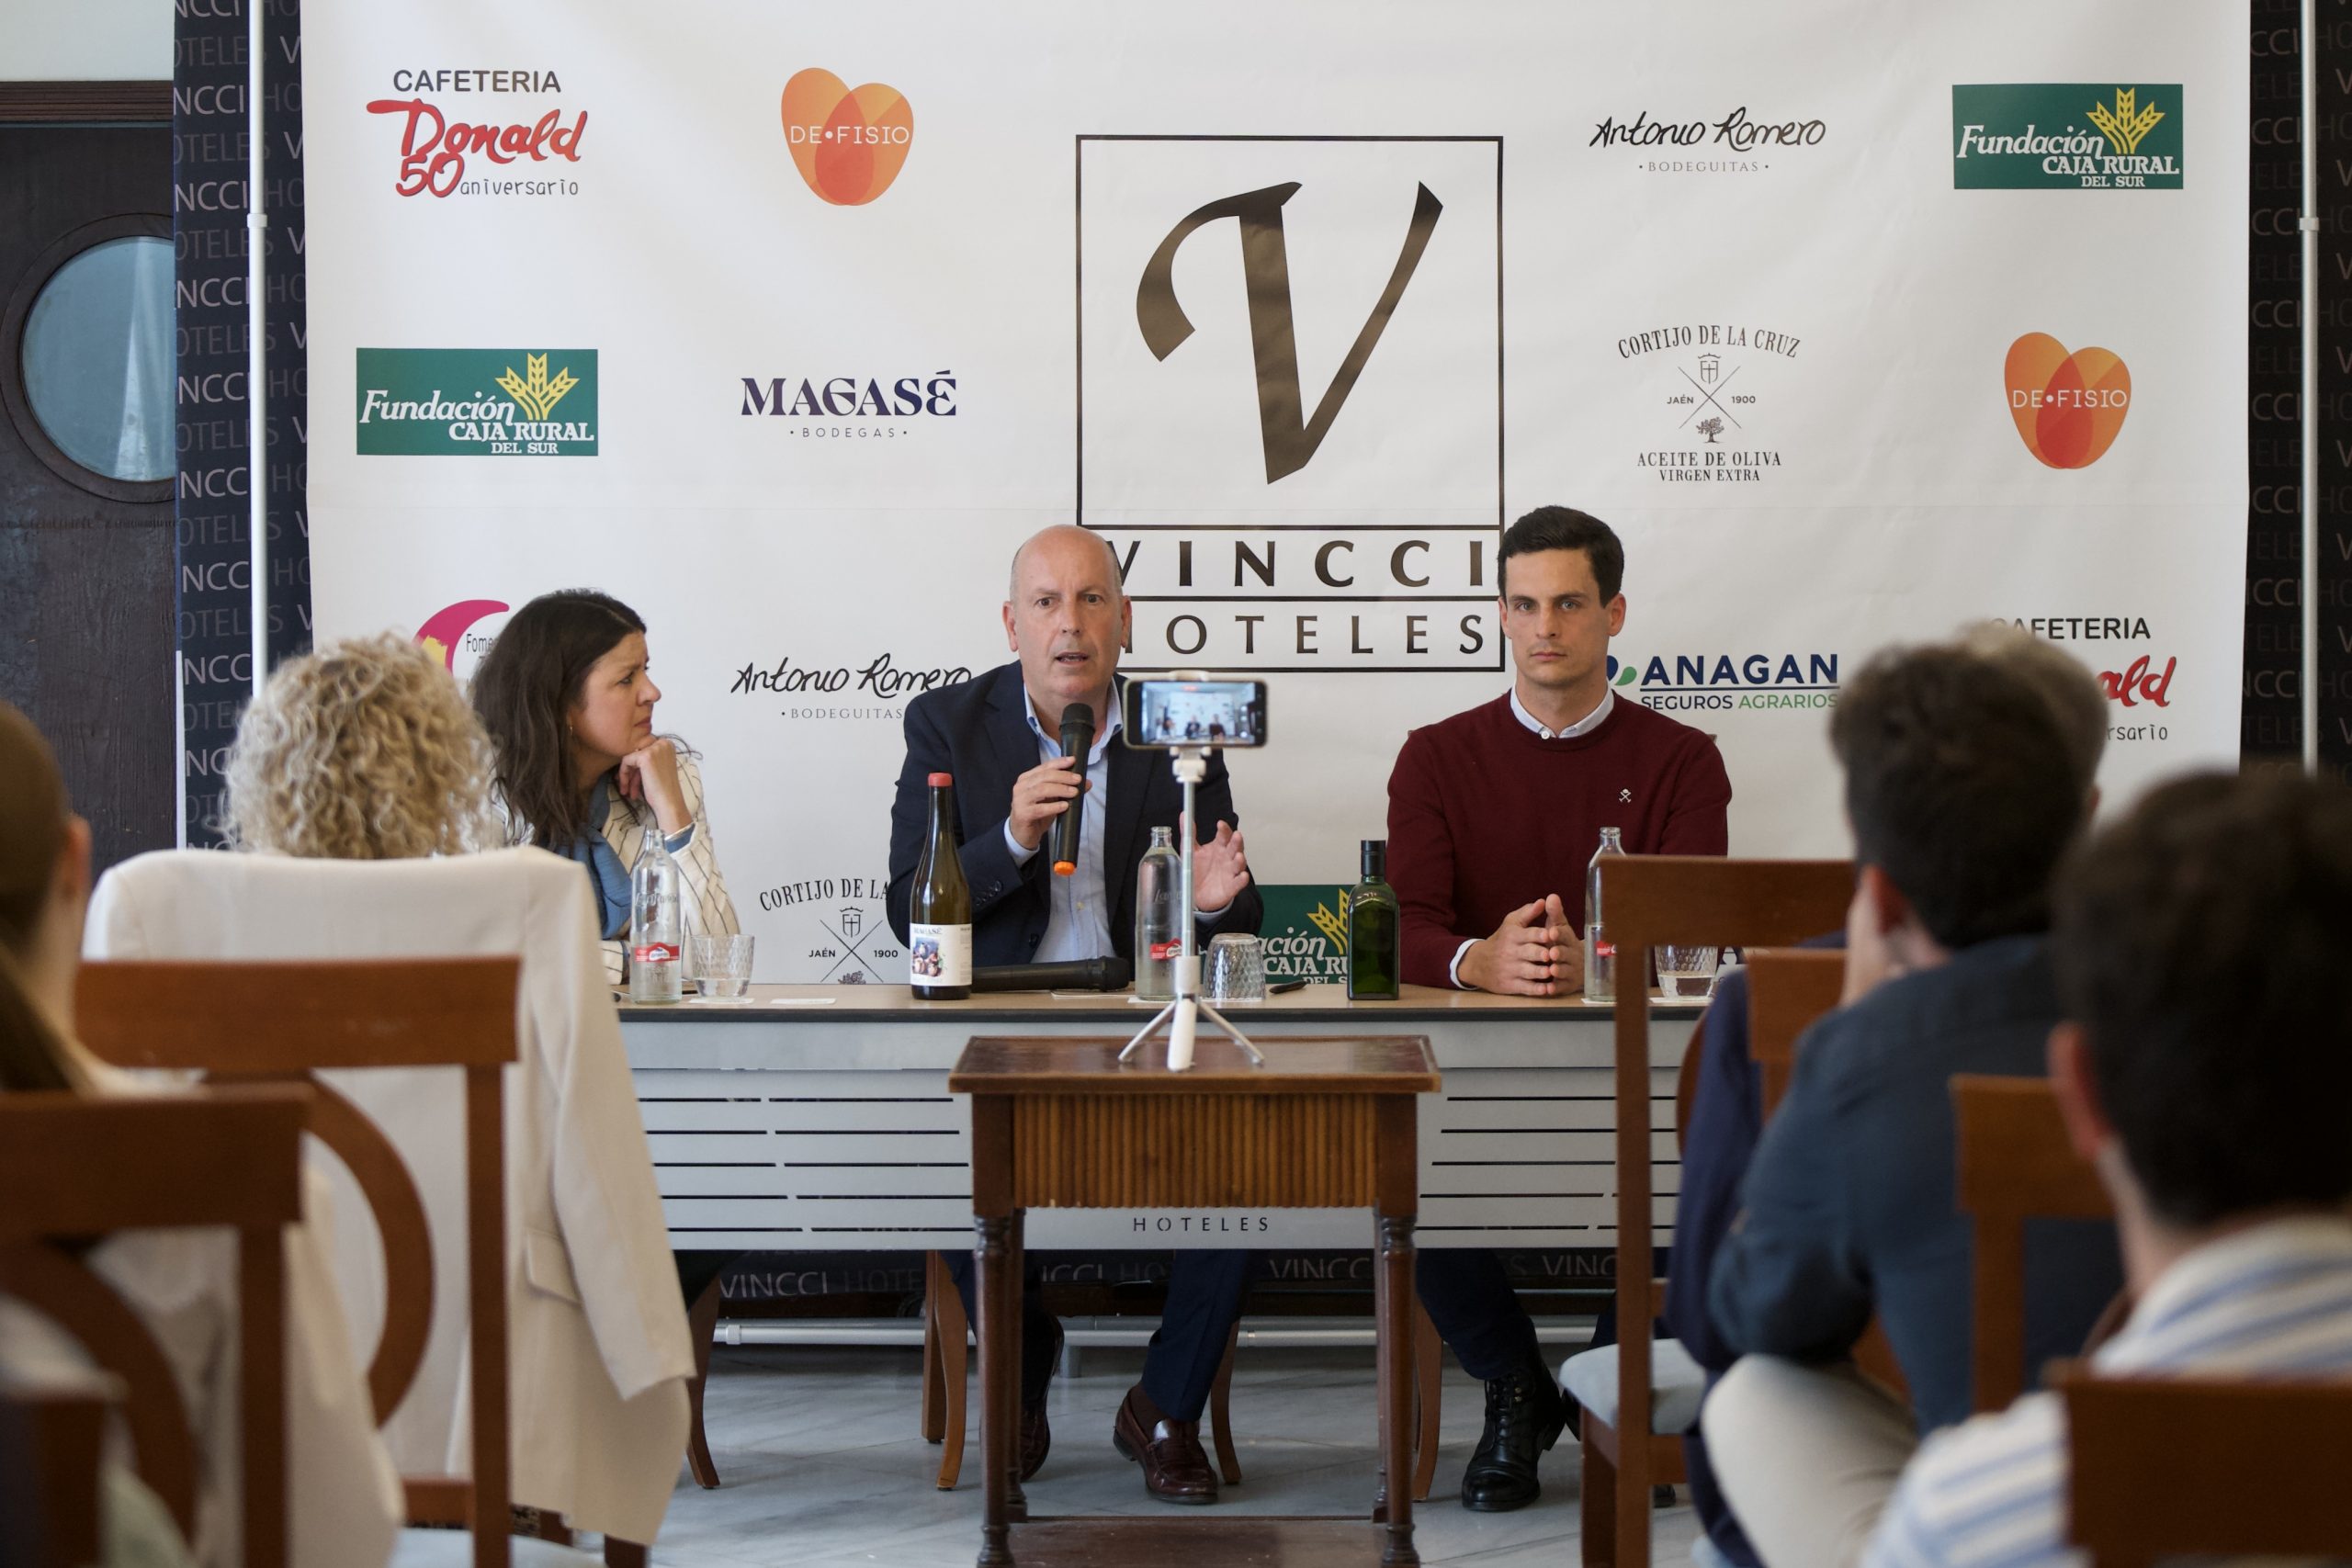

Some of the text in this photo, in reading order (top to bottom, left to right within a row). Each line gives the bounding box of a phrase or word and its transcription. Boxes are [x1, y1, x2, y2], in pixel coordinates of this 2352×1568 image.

[394, 70, 560, 93] CAFETERIA
[367, 99, 588, 163] Donald
[1589, 107, 1826, 152] Antonio Romero
[1956, 125, 2105, 159] Fundación
[395, 153, 579, 197] 50 aniversario
[1649, 162, 1758, 172] BODEGUITAS
[2041, 155, 2180, 175] CAJA RURAL
[2081, 176, 2145, 187] DEL SUR
[1136, 181, 1443, 484] V
[1619, 325, 1800, 358] CORTIJO DE LA CRUZ
[178, 371, 250, 404] NCC
[741, 370, 956, 416] MAGASÉ
[1667, 394, 1693, 404] JAÉN
[359, 389, 515, 426] Fundación
[448, 422, 594, 443] CAJA RURAL
[802, 427, 895, 438] BODEGAS
[491, 443, 559, 454] DEL SUR
[1638, 452, 1781, 466] ACEITE DE OLIVA
[180, 467, 247, 499] NCC
[1660, 469, 1759, 480] VIRGEN EXTRA
[183, 561, 249, 592] NCC
[184, 653, 251, 685] NCC
[731, 657, 849, 694] Antonio
[1641, 654, 1838, 685] ANAGAN
[791, 708, 903, 719] BODEGUITAS
[1641, 694, 1838, 710] SEGUROS AGRARIOS
[760, 879, 888, 910] CORTIJO DE LA
[808, 948, 835, 957] JAÉN
[1264, 957, 1319, 976] CAJA
[1134, 1217, 1267, 1231] HOTELES
[720, 1270, 829, 1298] VINCCI
